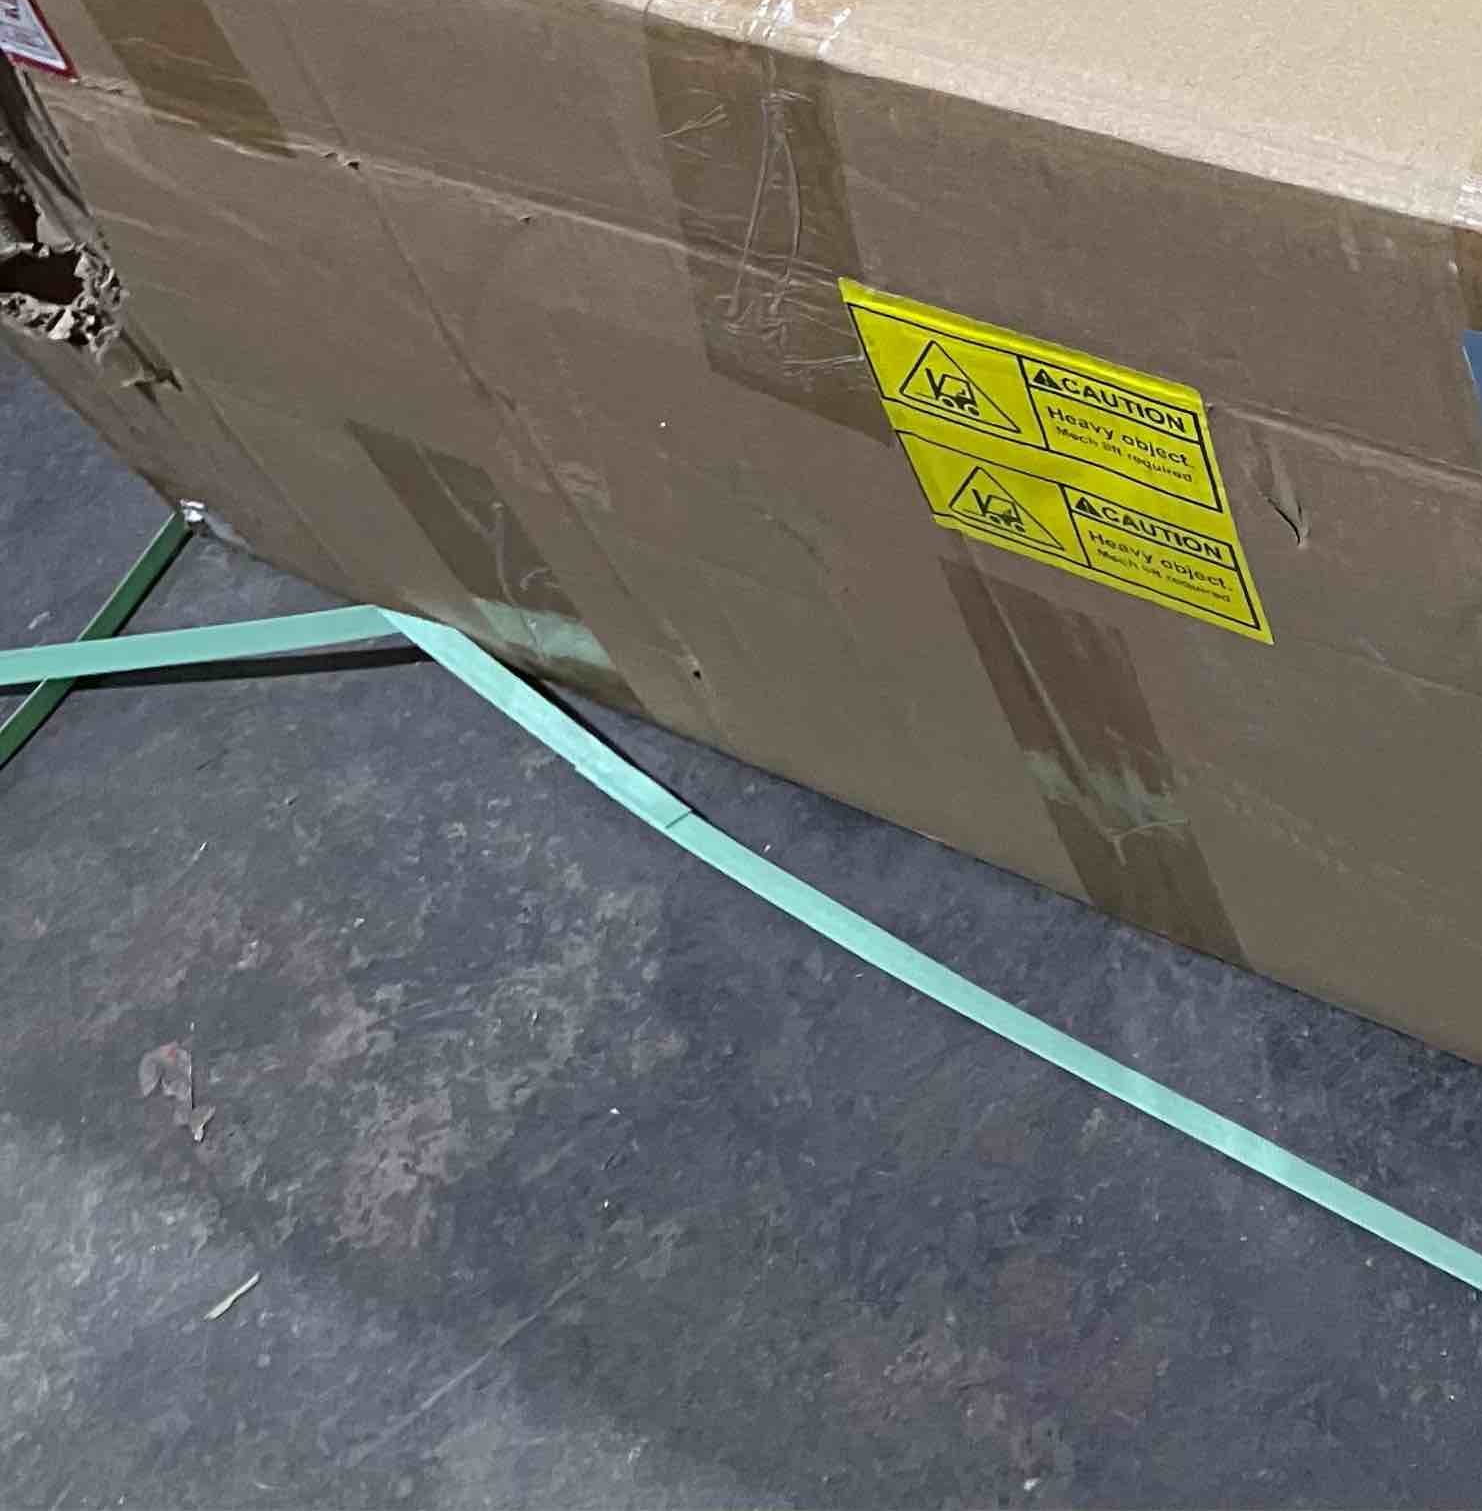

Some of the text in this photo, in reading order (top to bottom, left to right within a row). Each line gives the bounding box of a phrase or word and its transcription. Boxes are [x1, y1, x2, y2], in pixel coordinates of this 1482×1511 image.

[1047, 406, 1114, 440] Heavy
[1061, 378, 1187, 433] CAUTION
[1056, 426, 1098, 447] Mech
[1128, 453, 1193, 482] required
[1088, 530, 1153, 563] Heavy
[1102, 507, 1222, 560] CAUTION
